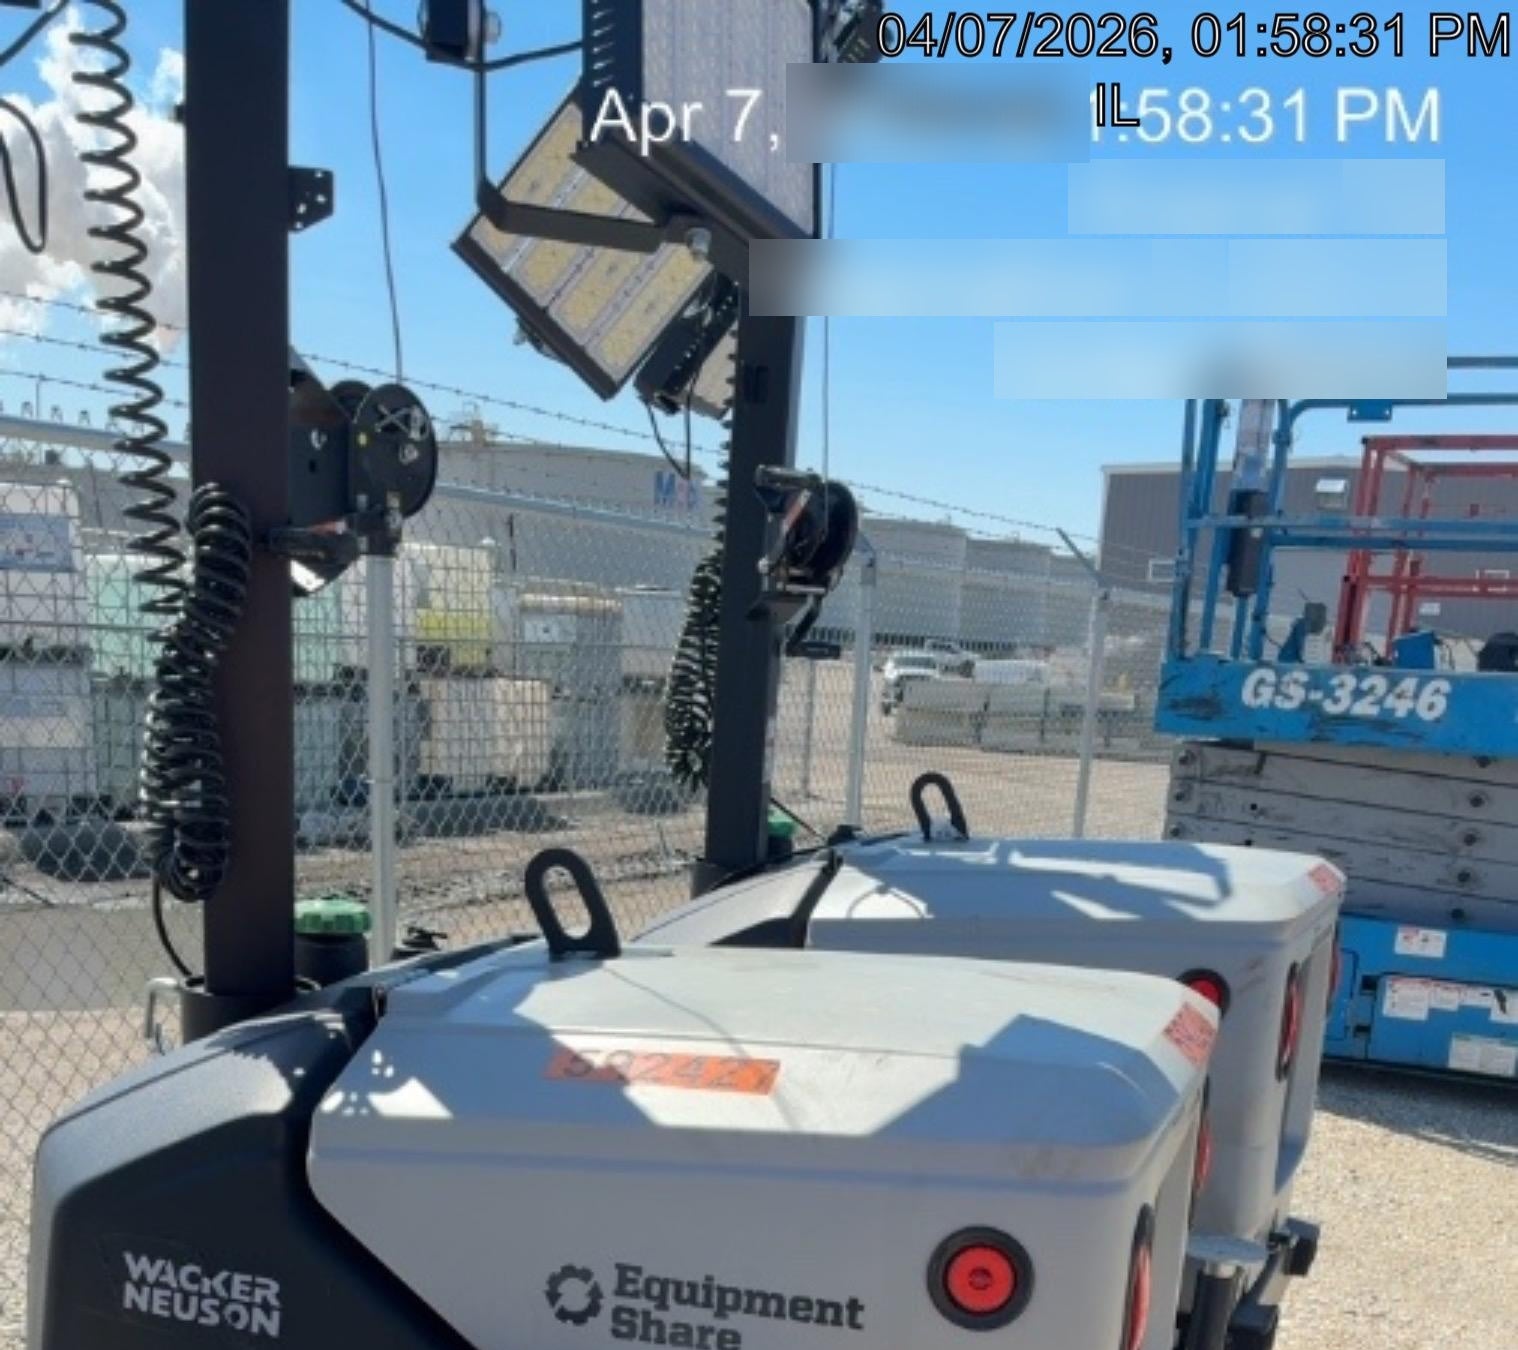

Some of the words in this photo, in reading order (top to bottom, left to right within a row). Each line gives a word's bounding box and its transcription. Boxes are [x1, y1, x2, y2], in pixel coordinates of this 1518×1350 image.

[1241, 668, 1452, 721] GS-3246
[123, 1251, 281, 1307] WACKER
[613, 1262, 865, 1331] Equipment
[123, 1281, 281, 1339] NEUSON
